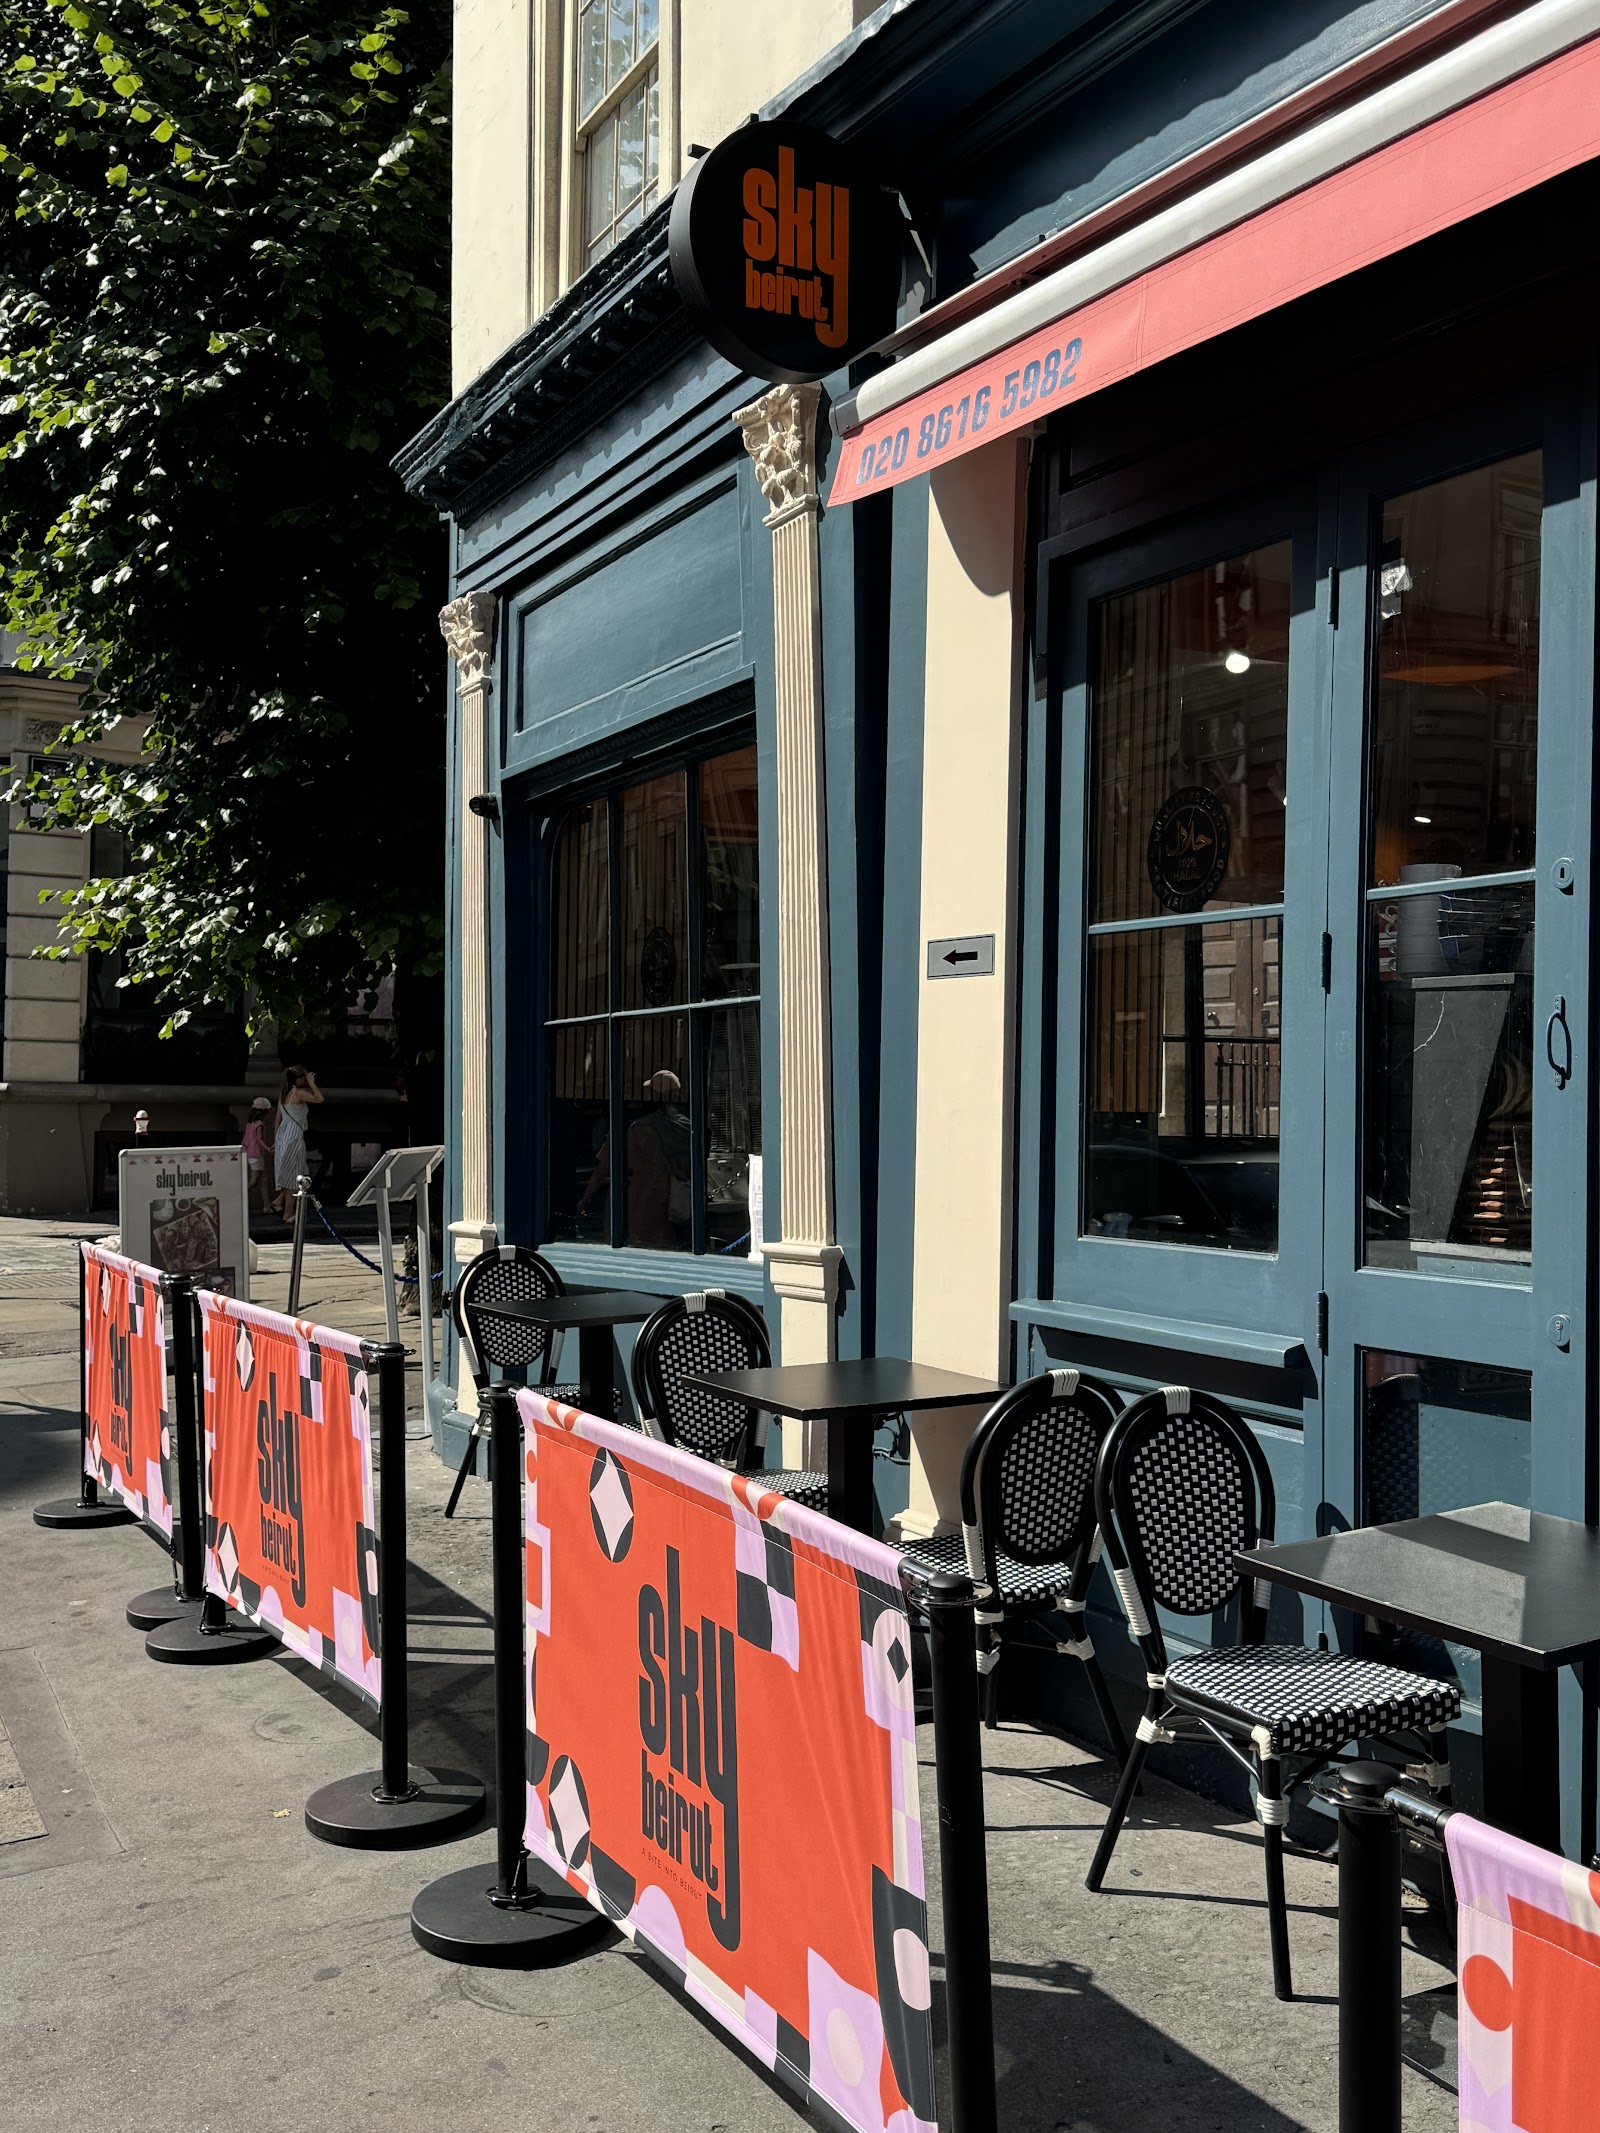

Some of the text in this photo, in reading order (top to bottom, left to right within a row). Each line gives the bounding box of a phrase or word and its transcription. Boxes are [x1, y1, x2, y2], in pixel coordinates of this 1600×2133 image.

[743, 145, 849, 348] sky
[745, 259, 828, 322] beirut
[856, 337, 1083, 485] 020 8616 5982
[156, 1165, 213, 1196] sky beirut
[256, 1372, 305, 1609] sky
[260, 1503, 297, 1577] beirut
[638, 1545, 741, 1952] sky
[641, 1749, 719, 1892] beirut
[648, 1852, 662, 1870] BITE
[663, 1867, 678, 1882] INTO
[680, 1878, 703, 1902] BEIRUT
